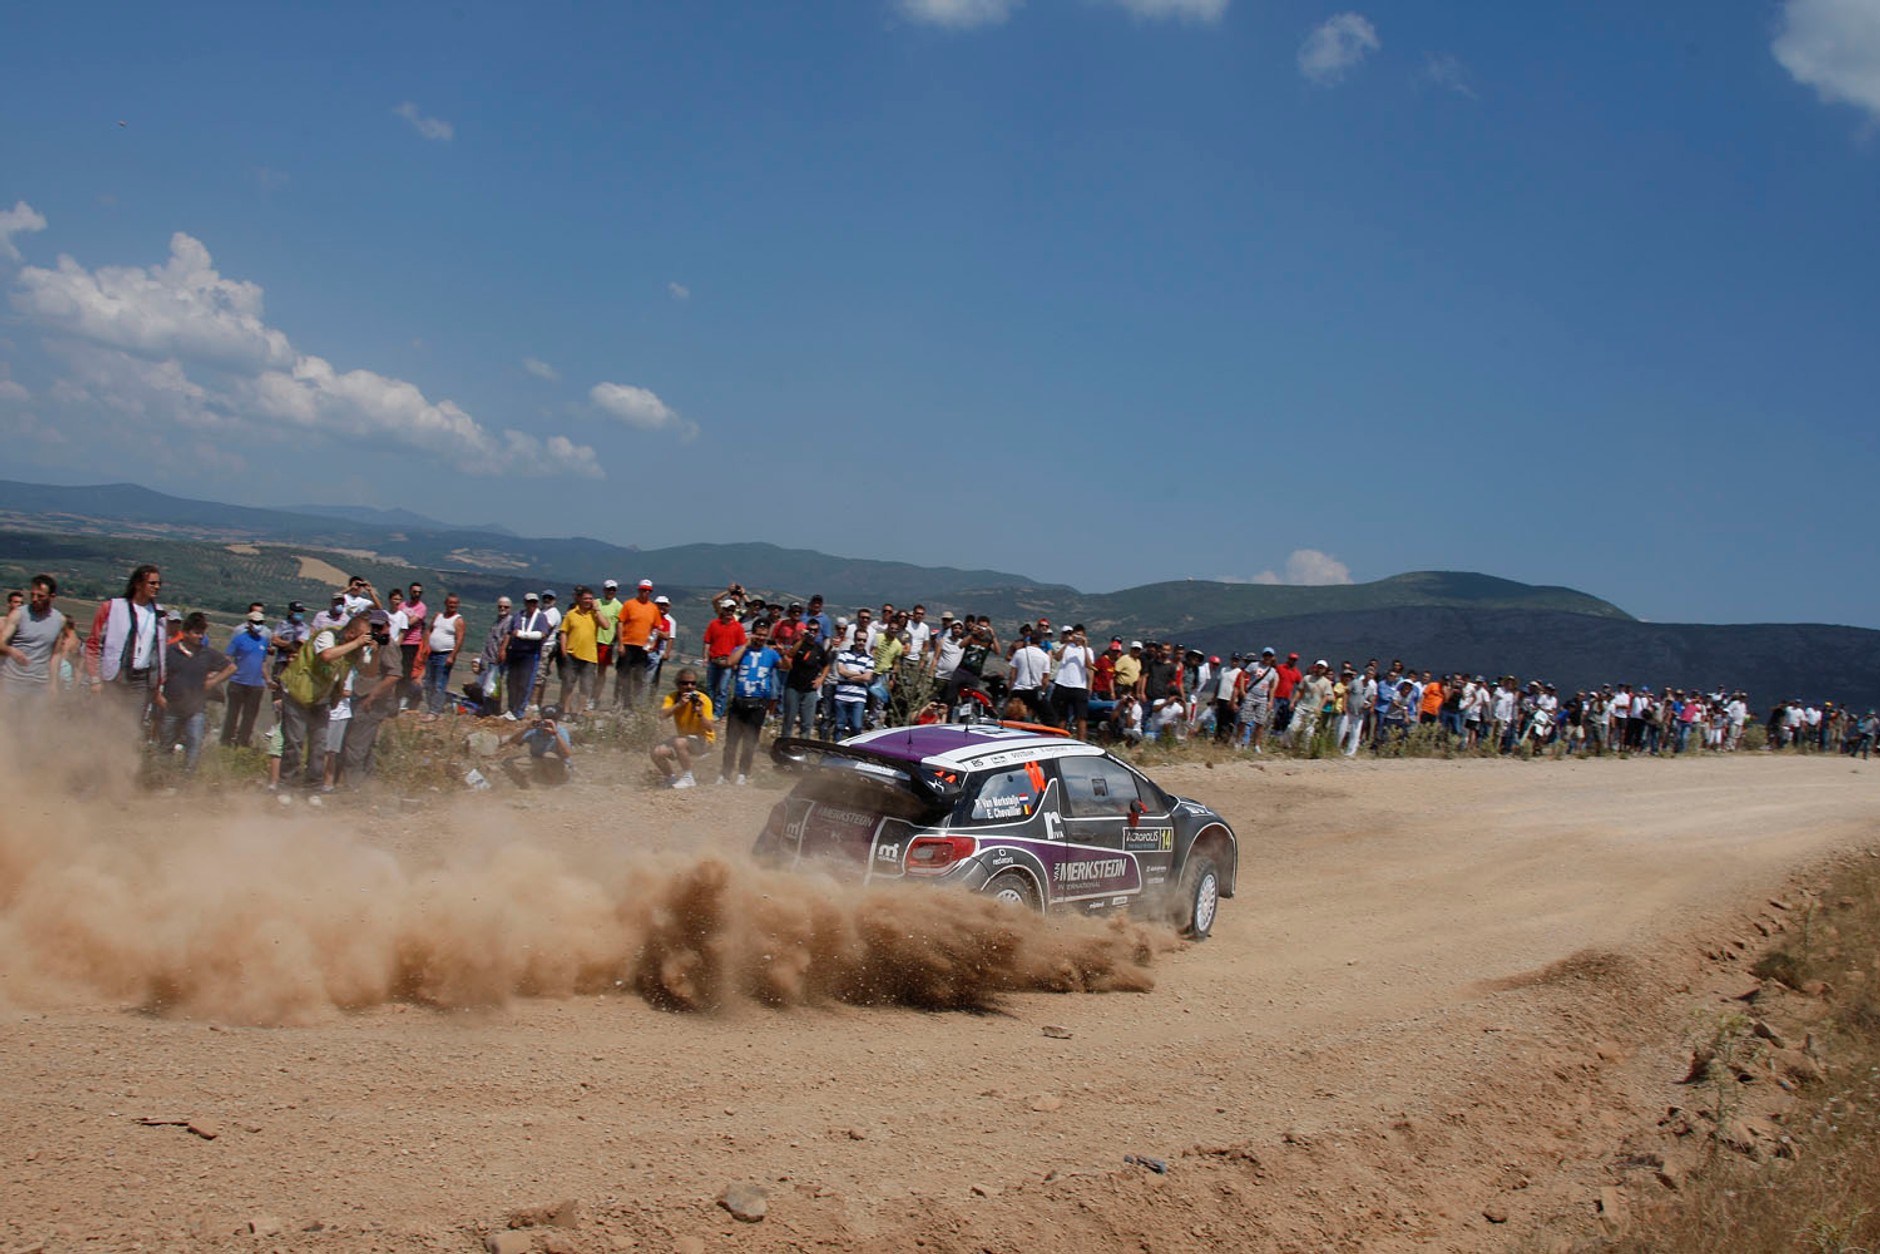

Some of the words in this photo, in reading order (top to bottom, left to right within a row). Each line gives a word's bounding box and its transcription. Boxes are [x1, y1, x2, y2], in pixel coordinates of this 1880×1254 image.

[981, 799, 993, 808] Van
[986, 809, 994, 818] E.
[1162, 830, 1171, 849] 14
